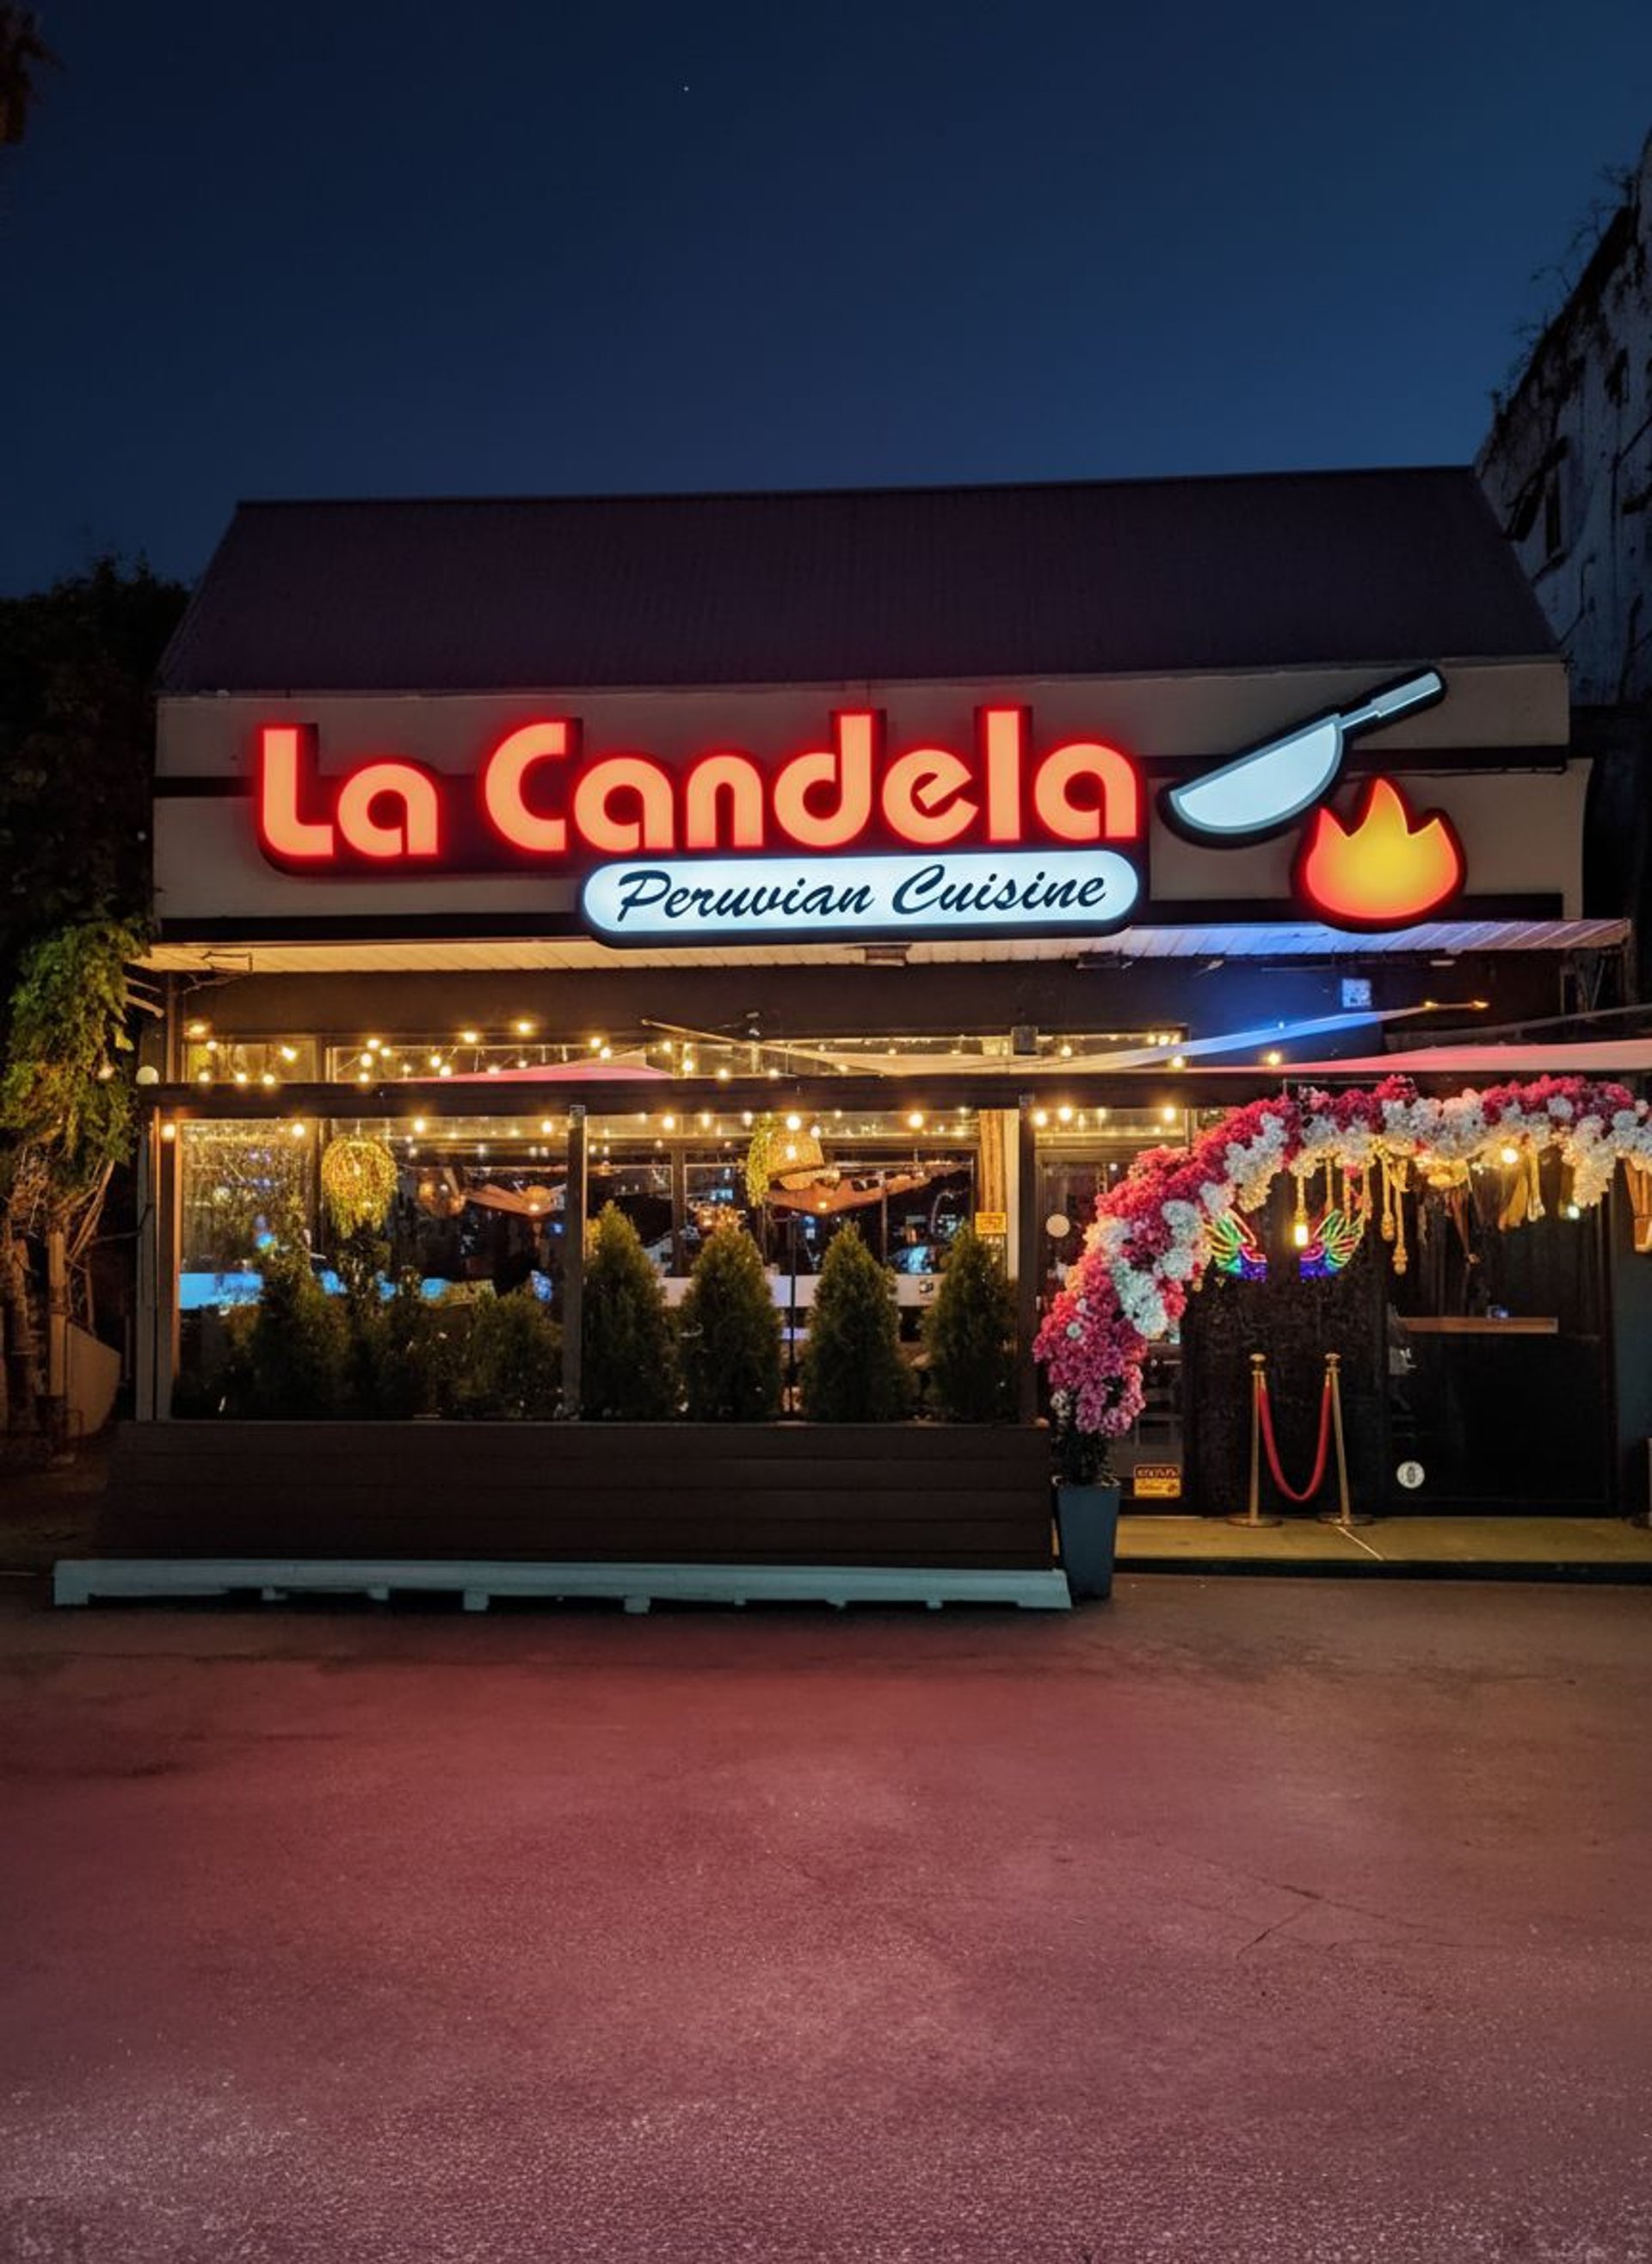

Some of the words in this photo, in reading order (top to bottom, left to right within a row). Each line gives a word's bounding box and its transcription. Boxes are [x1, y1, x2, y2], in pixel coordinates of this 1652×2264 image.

[262, 728, 439, 857] La
[484, 710, 1137, 852] Candela
[617, 869, 875, 922] Peruvian
[891, 863, 1106, 915] Cuisine
